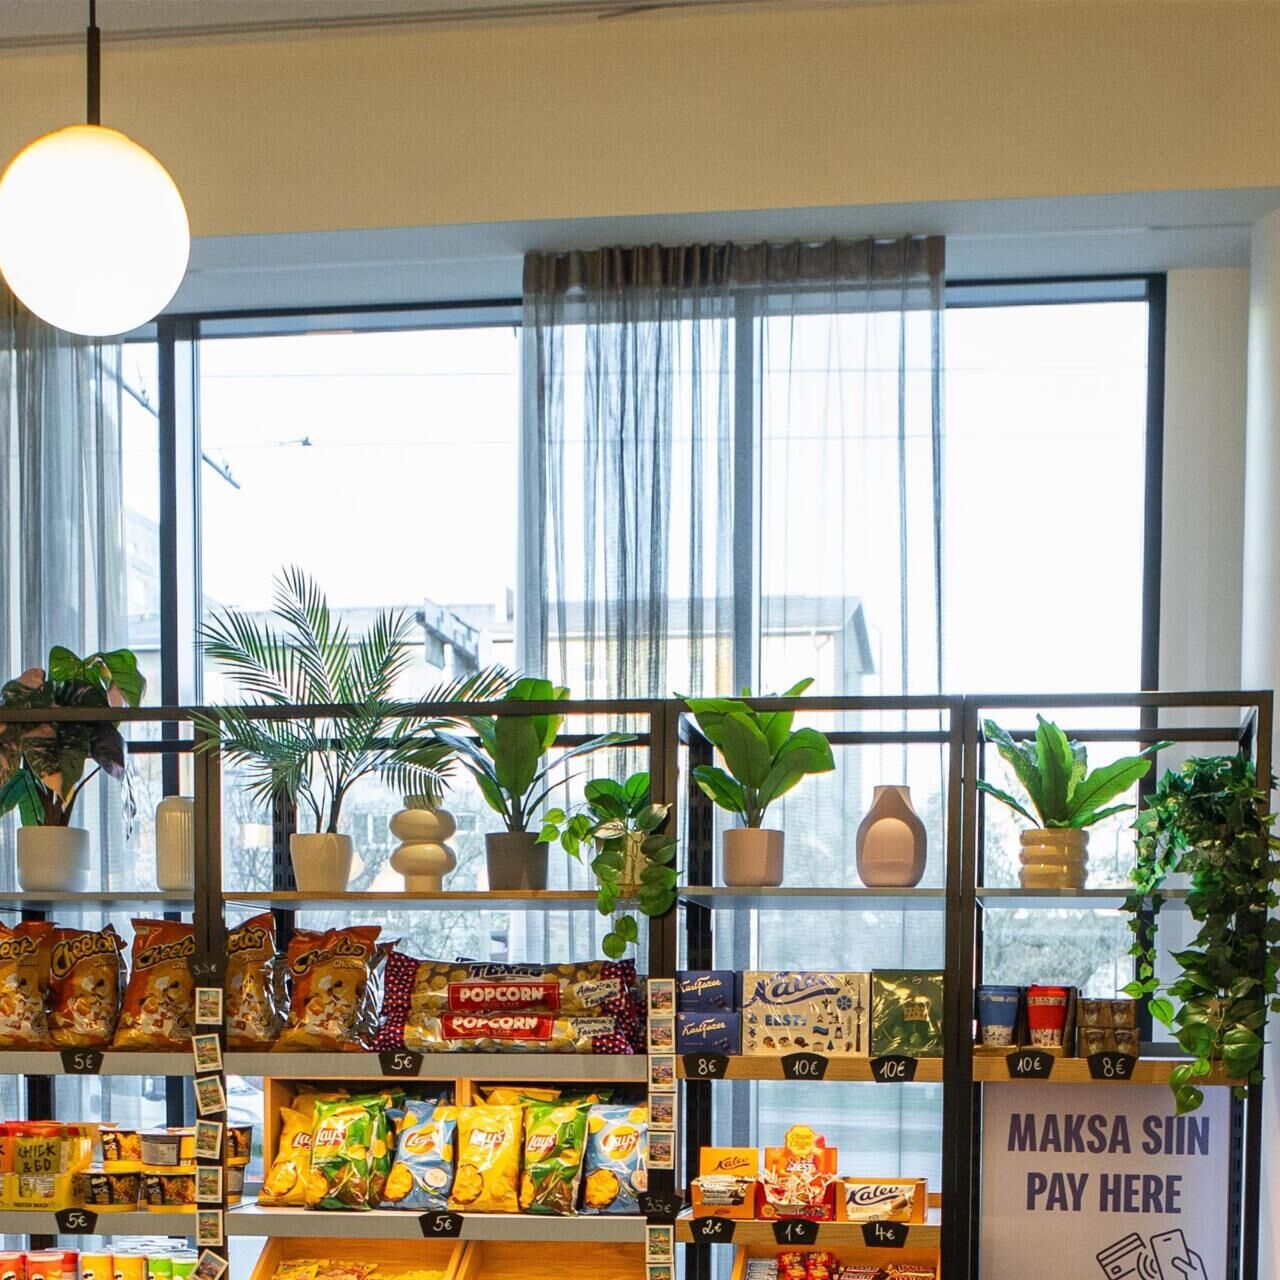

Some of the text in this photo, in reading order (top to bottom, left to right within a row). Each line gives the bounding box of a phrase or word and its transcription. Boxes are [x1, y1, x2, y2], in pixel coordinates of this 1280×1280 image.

[135, 937, 196, 972] Cheeto
[459, 986, 544, 1002] POPCORN
[451, 1015, 539, 1032] POPCORN
[74, 1054, 93, 1070] 5€
[392, 1054, 413, 1070] 5€
[698, 1059, 716, 1074] 8€
[792, 1060, 819, 1076] 10€
[879, 1060, 905, 1077] 10€
[1017, 1057, 1042, 1073] 10€
[1102, 1057, 1126, 1077] 8€
[1007, 1113, 1210, 1155] MAKSA SIIN
[17, 1142, 56, 1158] CHICK
[714, 1156, 750, 1172] Kalev
[848, 1185, 904, 1206] Kalev
[1026, 1172, 1183, 1214] PAY HERE
[66, 1212, 88, 1229] 5€
[433, 1215, 453, 1232] 5€
[702, 1222, 722, 1235] 2€
[875, 1226, 895, 1241] 4€
